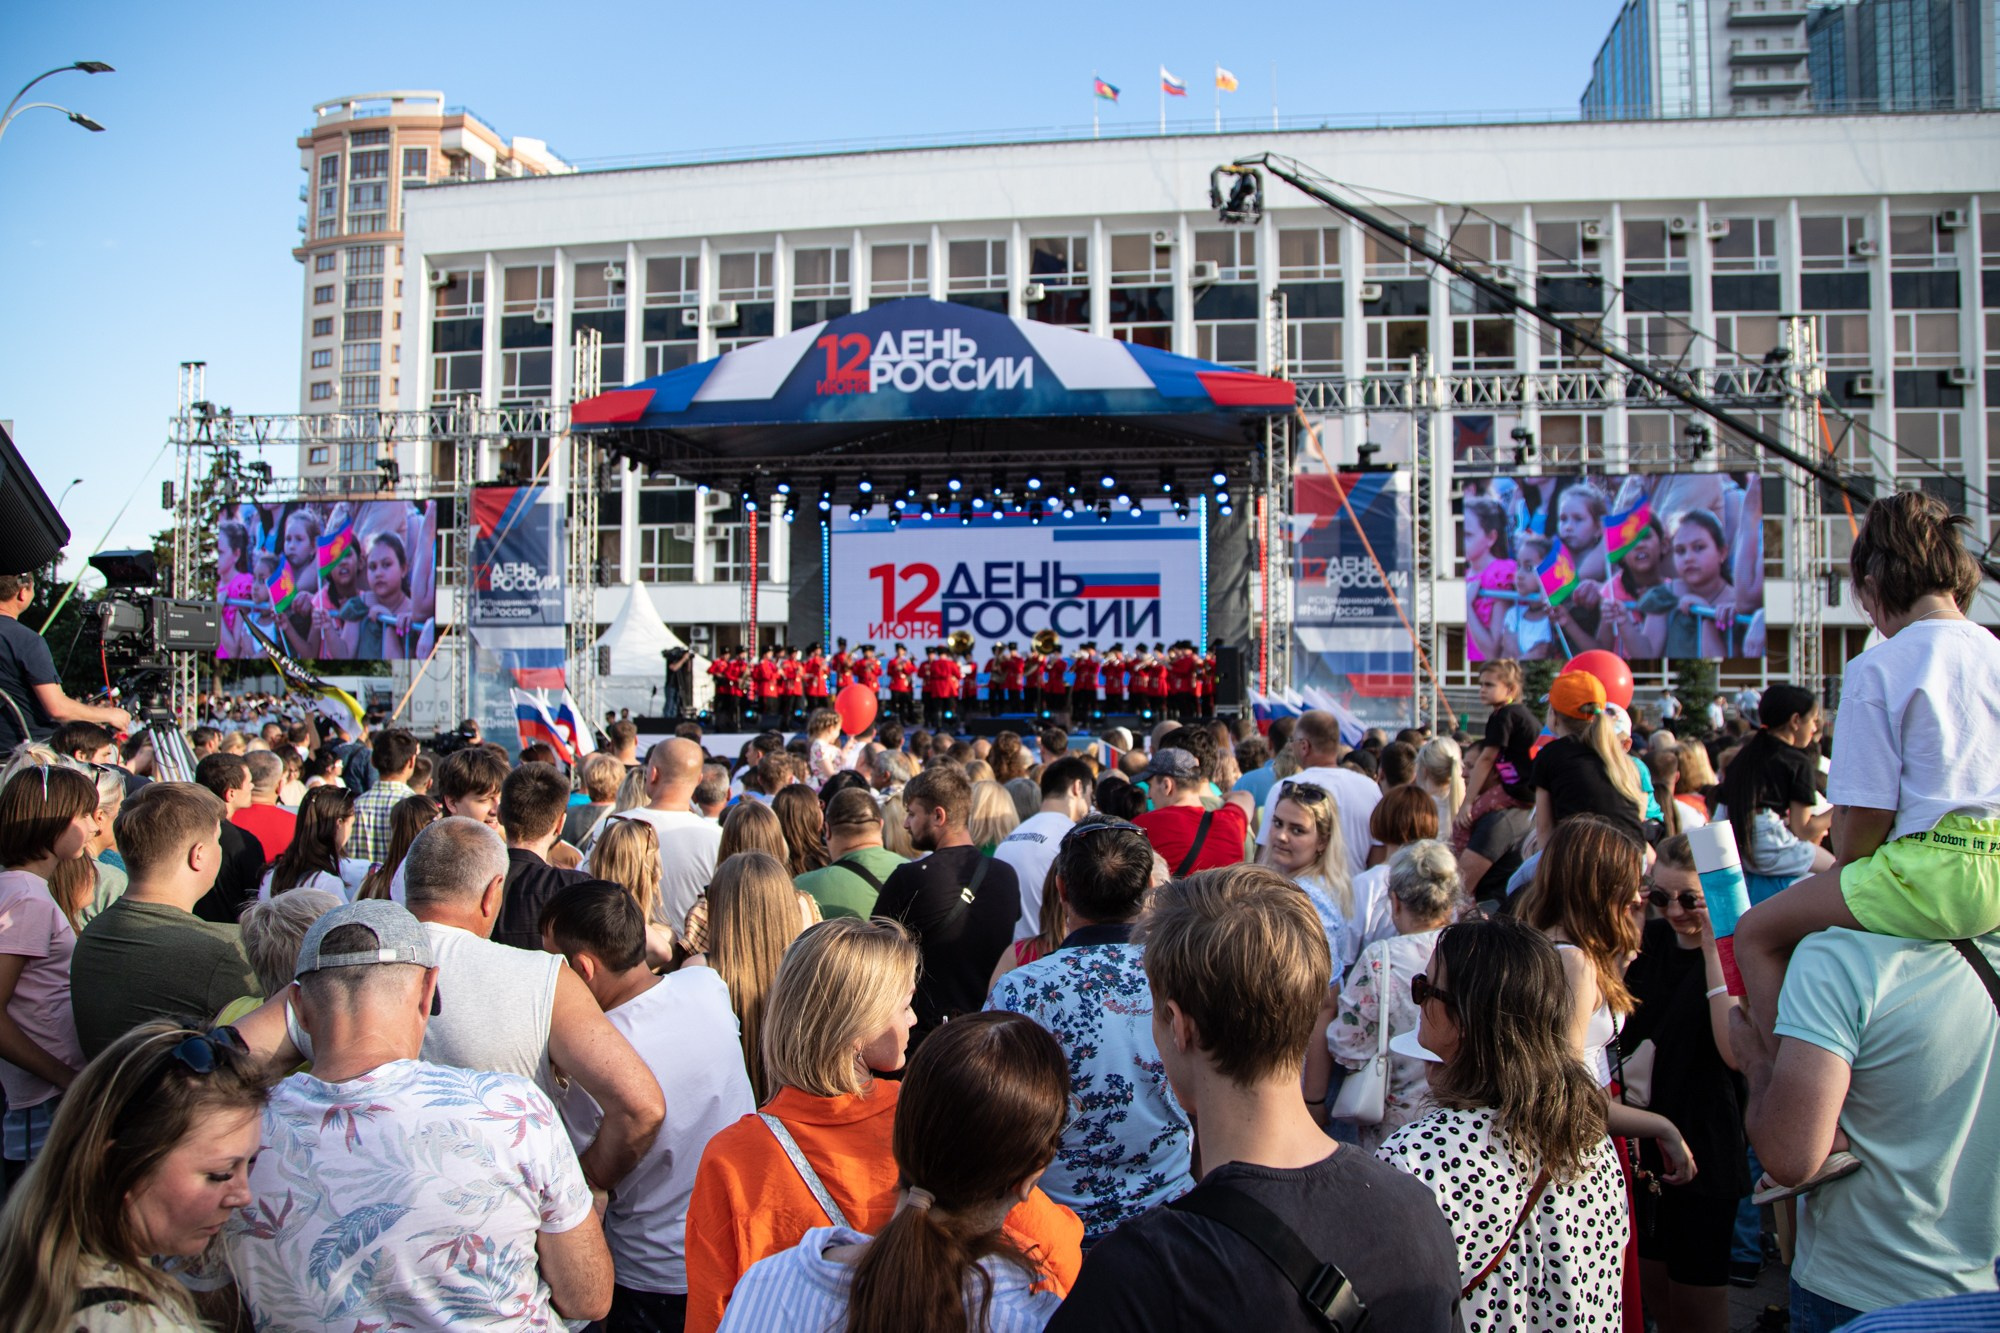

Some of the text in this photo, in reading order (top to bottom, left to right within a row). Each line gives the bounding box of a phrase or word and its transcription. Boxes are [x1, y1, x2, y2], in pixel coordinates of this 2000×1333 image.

[816, 328, 978, 380] 12 ДЕНЬ
[869, 356, 1033, 393] РОССИИ
[490, 576, 560, 591] РОССИИ
[491, 562, 537, 578] ДЕНЬ
[1298, 557, 1327, 581] 12
[869, 560, 1085, 622] 12 ДЕНЬ
[869, 599, 1160, 639] ИЮНЯ РОССИИ
[1905, 831, 1926, 842] eep
[1933, 831, 1967, 847] down
[1973, 837, 1985, 850] in
